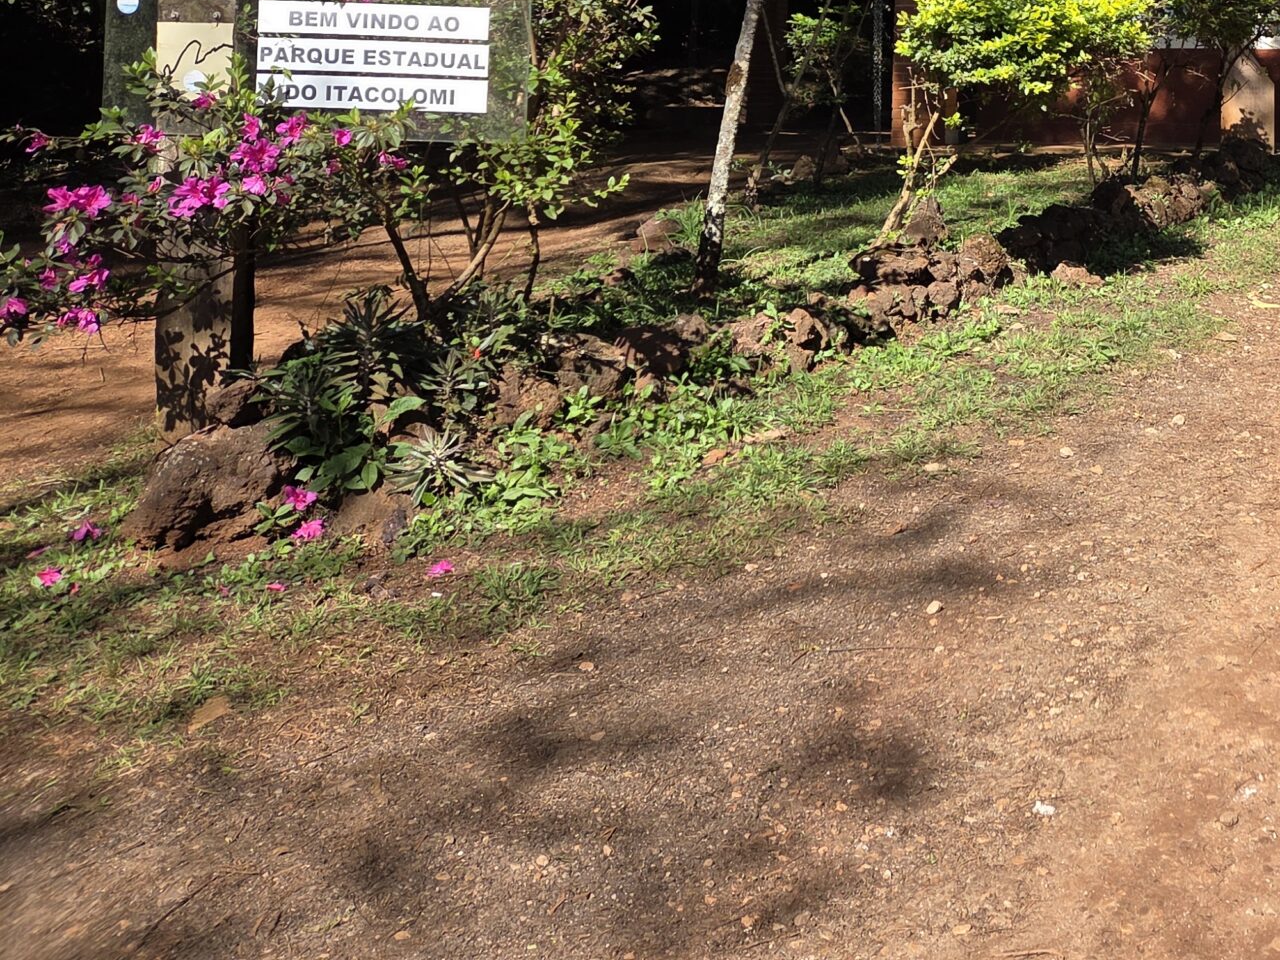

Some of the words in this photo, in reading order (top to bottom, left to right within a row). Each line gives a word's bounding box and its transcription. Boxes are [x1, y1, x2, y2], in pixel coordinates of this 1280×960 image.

[288, 10, 338, 28] BEM
[346, 12, 420, 31] VINDO
[427, 15, 460, 32] AO
[260, 46, 355, 66] PARQUE
[363, 49, 486, 70] ESTADUAL
[285, 84, 317, 101] DO
[325, 85, 455, 106] ITACOLOMI
